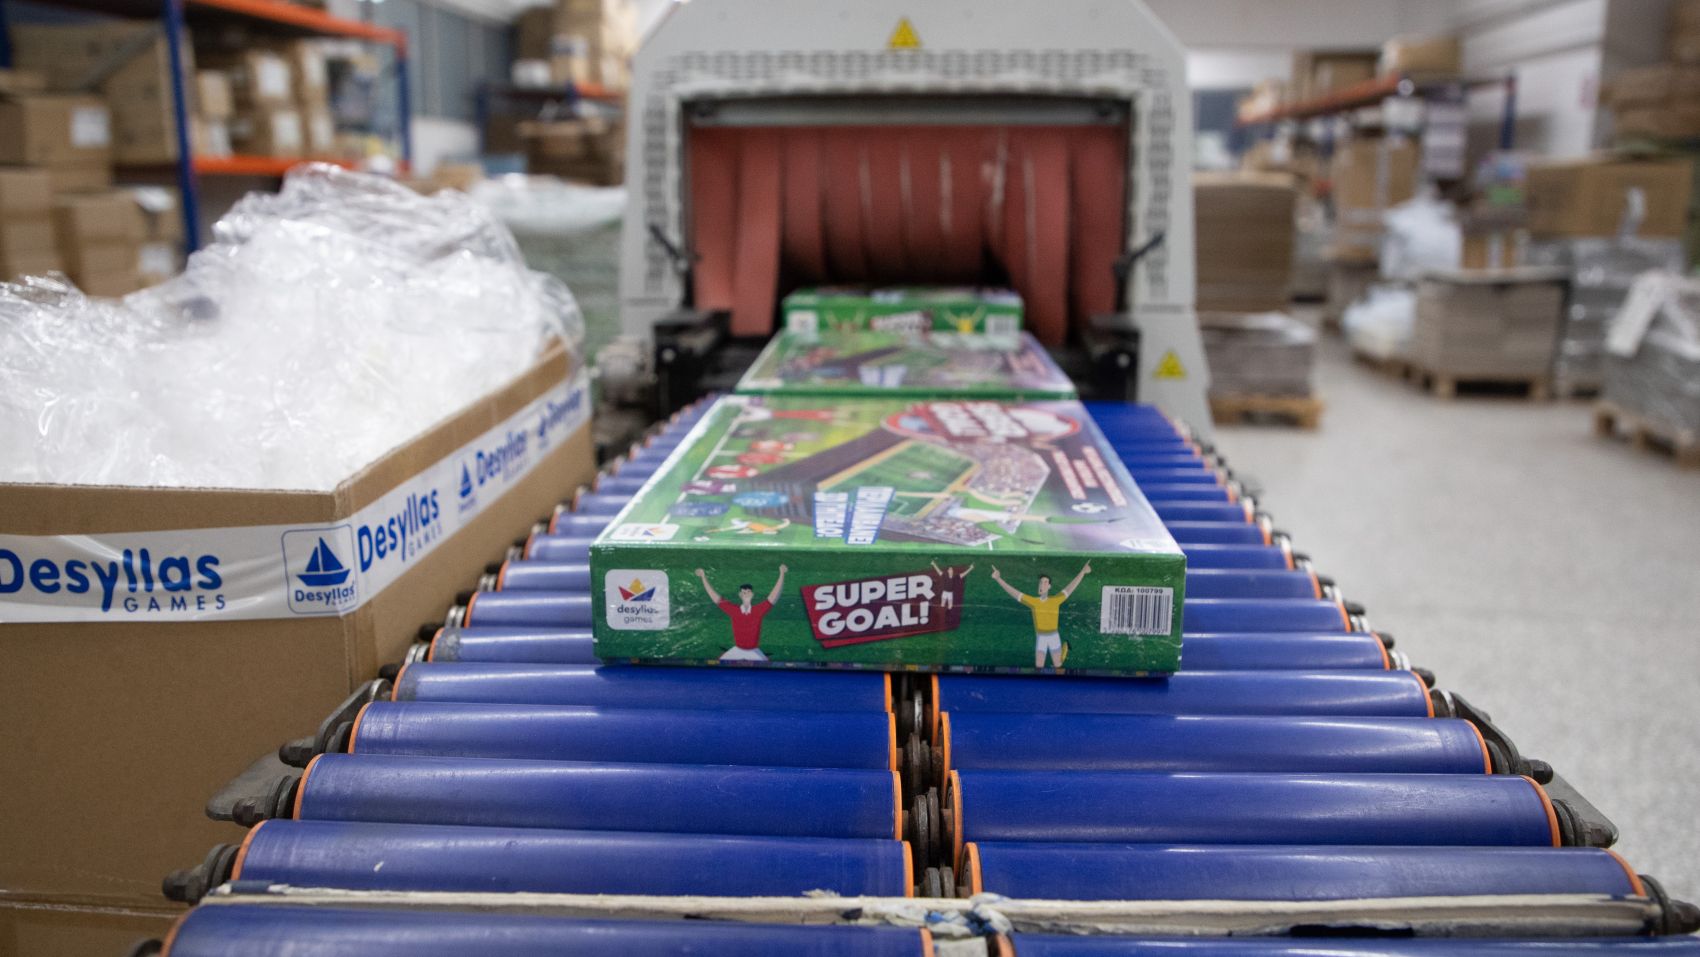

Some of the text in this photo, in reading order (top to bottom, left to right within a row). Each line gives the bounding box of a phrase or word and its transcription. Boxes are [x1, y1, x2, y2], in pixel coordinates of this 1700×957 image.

[357, 488, 439, 573] Desyllas
[0, 548, 223, 612] Desyllas
[295, 583, 354, 605] Desyllas
[813, 574, 936, 611] SUPER
[123, 593, 226, 613] GAMES
[817, 600, 930, 636] GOAL!
